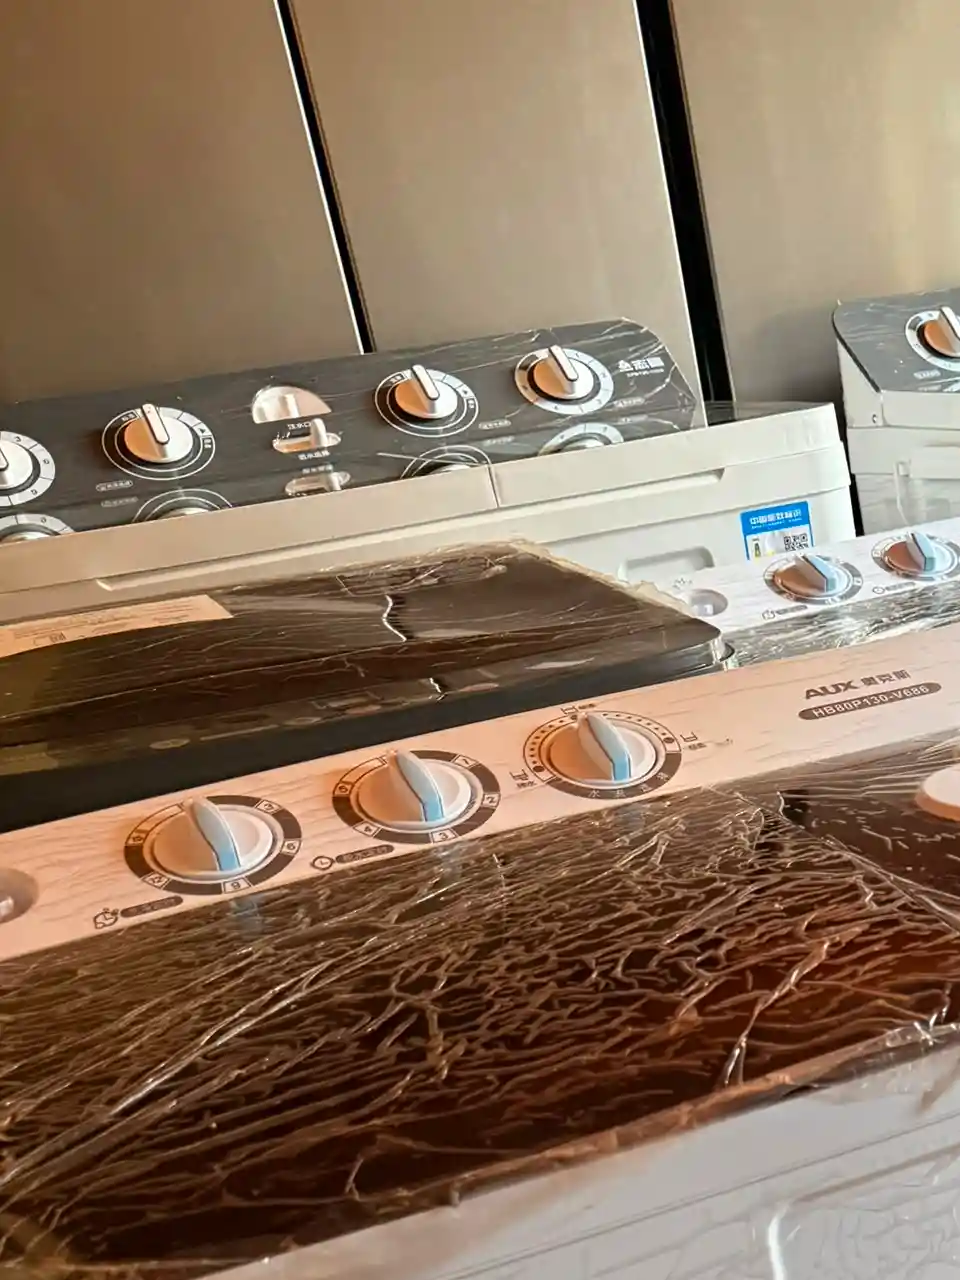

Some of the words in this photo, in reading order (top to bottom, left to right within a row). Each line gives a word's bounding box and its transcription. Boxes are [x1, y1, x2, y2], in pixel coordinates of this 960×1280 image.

[805, 680, 858, 700] AUX
[860, 669, 912, 686] 奥克斯
[812, 685, 930, 718] HB80P130-V686
